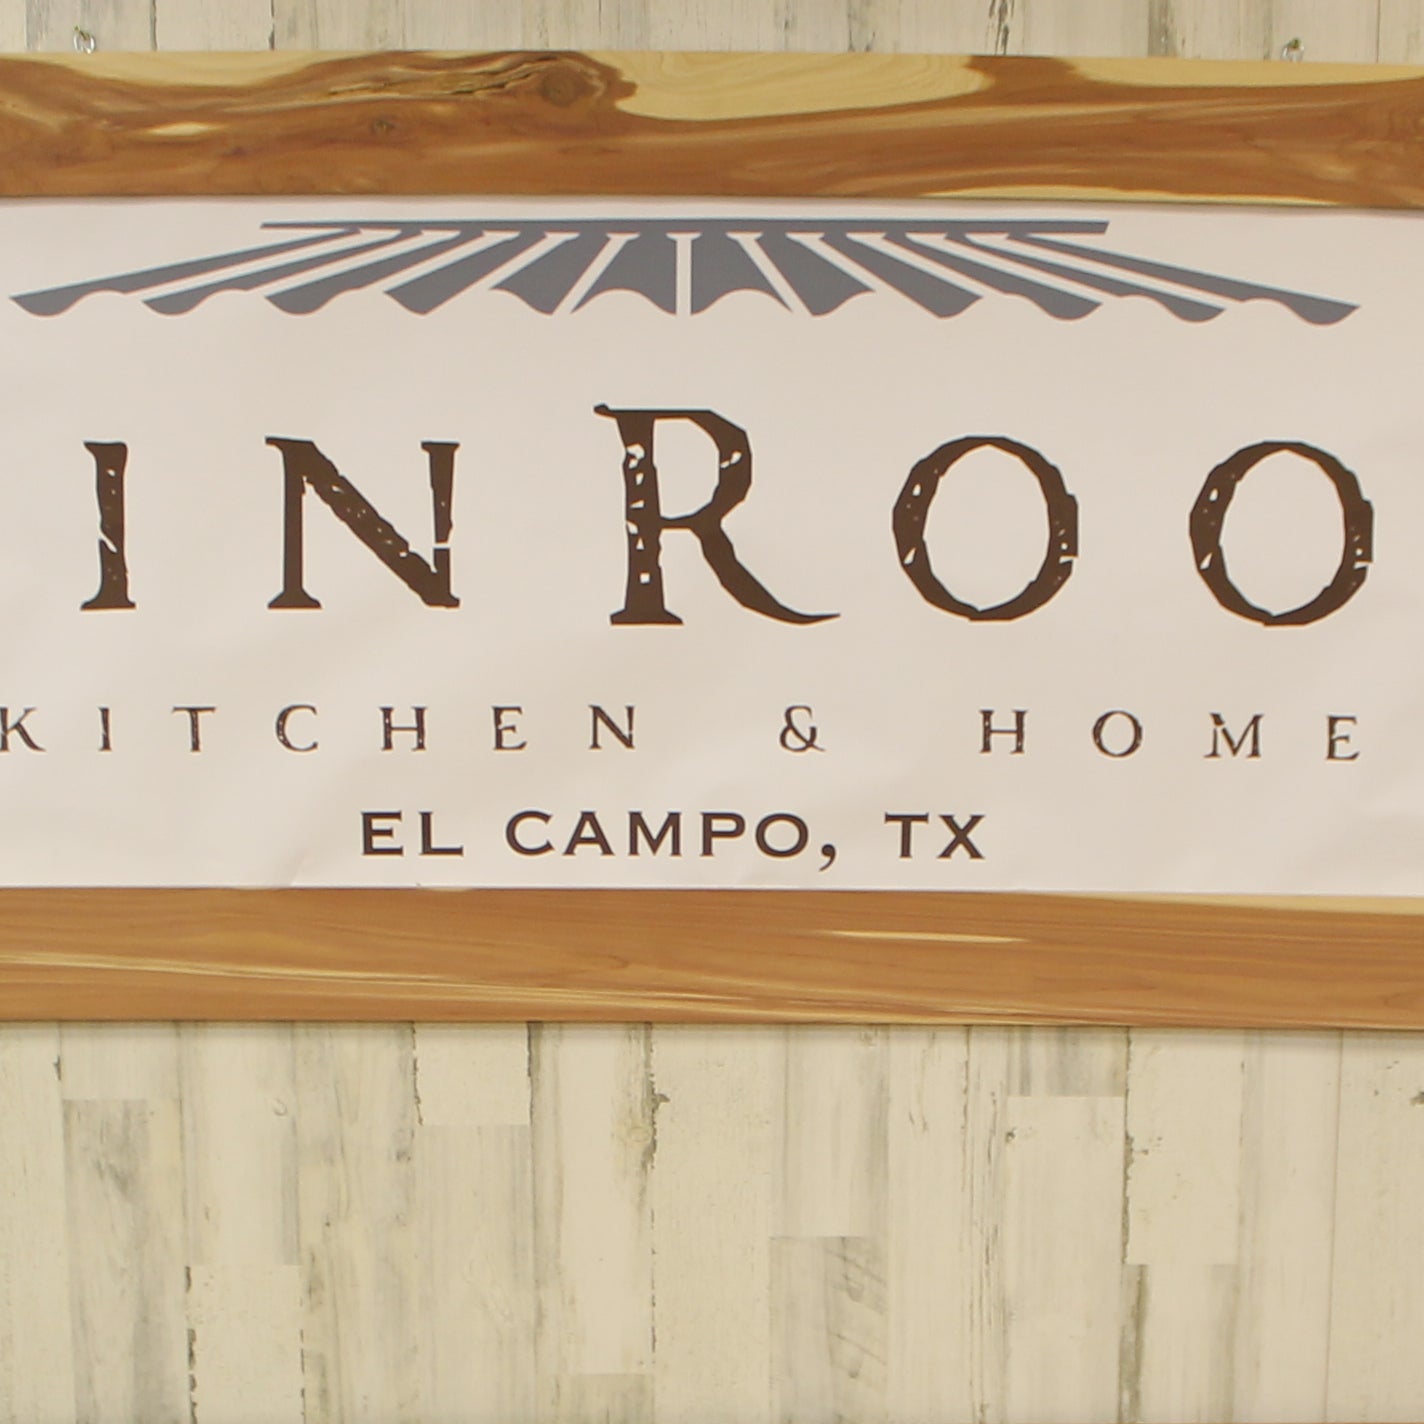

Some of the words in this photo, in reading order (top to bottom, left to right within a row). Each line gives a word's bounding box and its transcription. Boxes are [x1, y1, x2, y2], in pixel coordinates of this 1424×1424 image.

[779, 705, 828, 755] &
[980, 710, 1359, 762] HOME
[361, 811, 463, 857] EL
[505, 810, 837, 872] CAMPO,
[884, 813, 984, 860] TX
